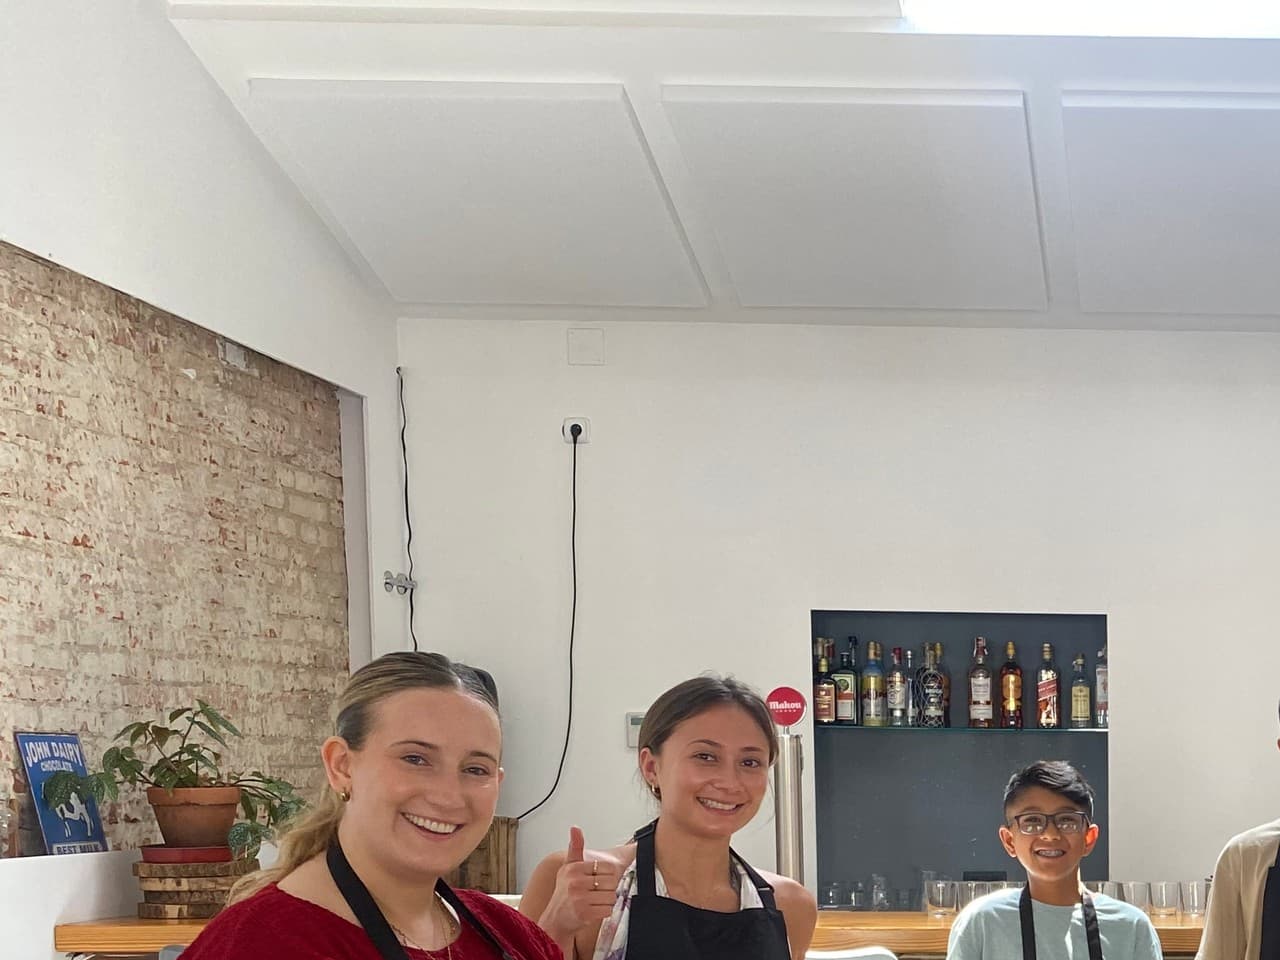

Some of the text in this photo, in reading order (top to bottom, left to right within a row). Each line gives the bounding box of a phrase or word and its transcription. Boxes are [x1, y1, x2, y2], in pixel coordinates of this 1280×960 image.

[769, 700, 801, 710] Mahou
[25, 741, 83, 768] JOHN DAIRY
[40, 760, 74, 772] CHOCOLATE
[56, 845, 77, 855] BEST
